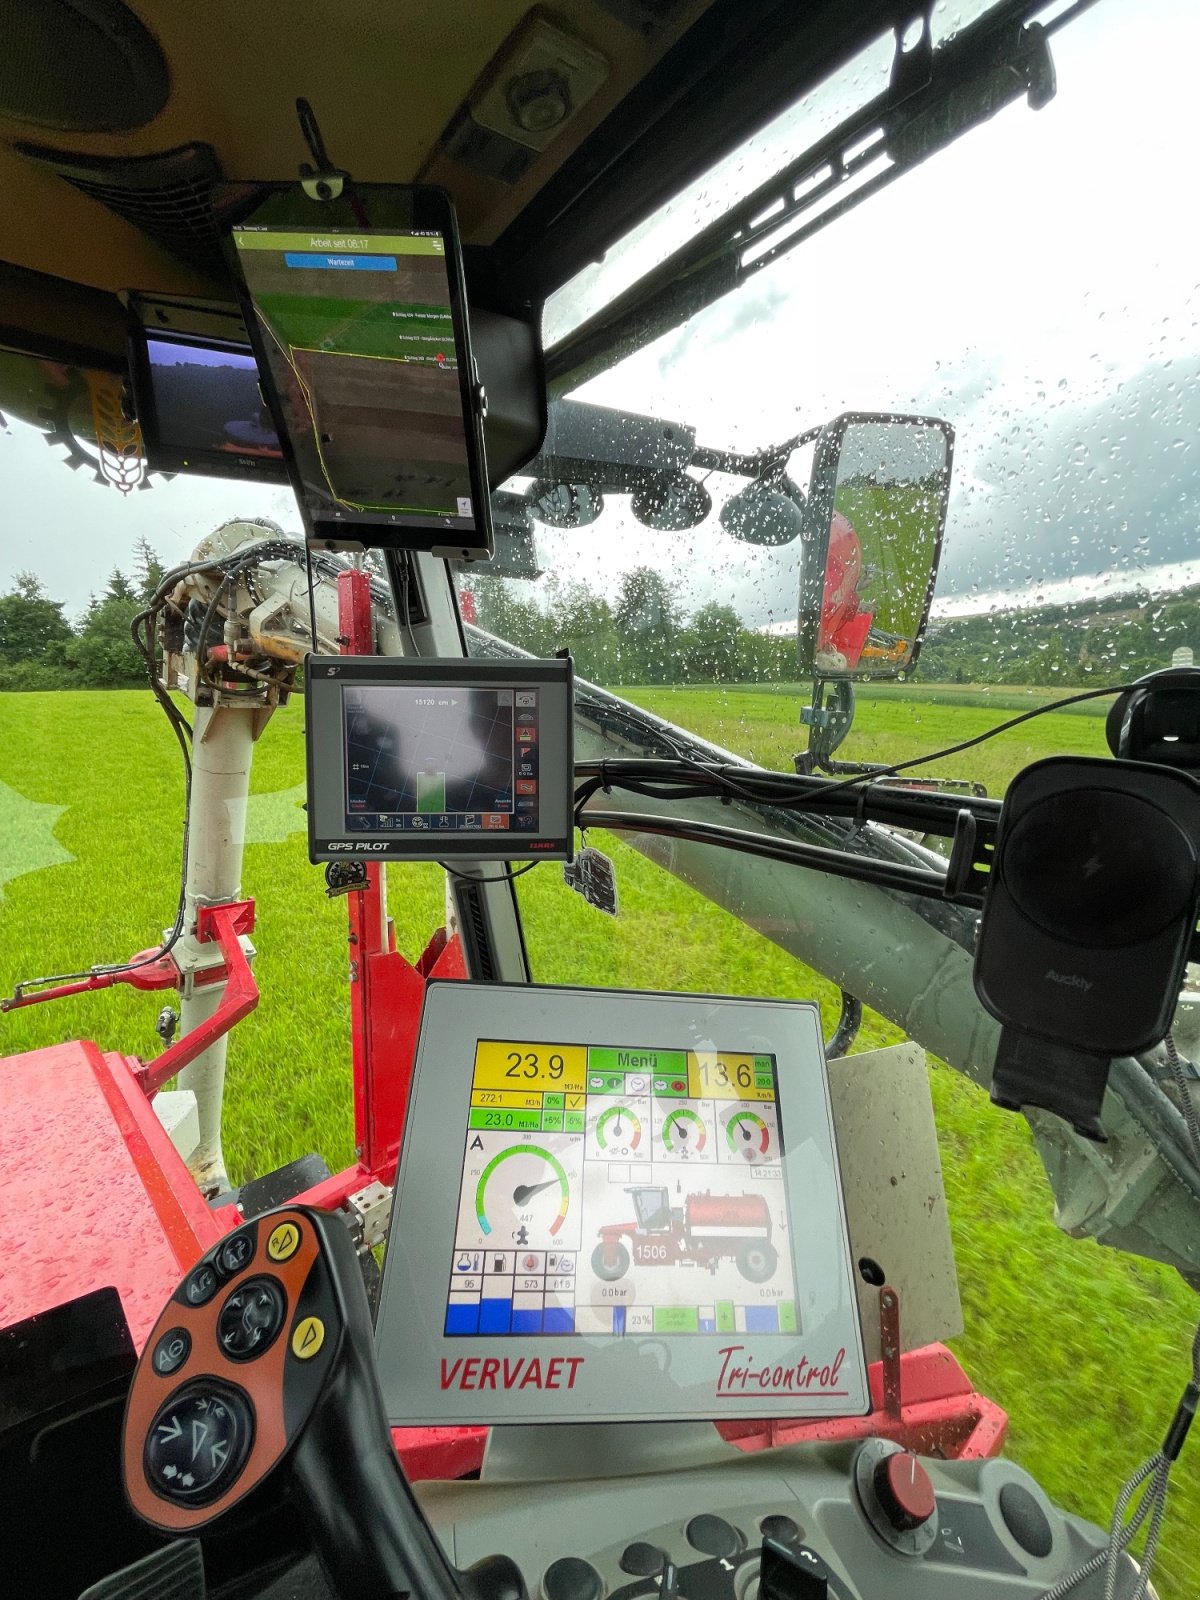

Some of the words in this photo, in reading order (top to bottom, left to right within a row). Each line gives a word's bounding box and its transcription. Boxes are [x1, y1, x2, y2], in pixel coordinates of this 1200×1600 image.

[310, 238, 332, 248] Arbeit
[333, 239, 346, 248] seit
[327, 258, 355, 267] Wartezeit
[327, 842, 354, 851] GPS
[355, 842, 390, 851] PILOT
[505, 1052, 564, 1080] 23.9
[618, 1052, 658, 1068] Menü
[700, 1061, 752, 1088] 13.6
[480, 1093, 503, 1103] 272.1
[546, 1096, 560, 1105] 0%
[485, 1112, 514, 1126] 23.0
[470, 1134, 484, 1151] A
[519, 1214, 534, 1223] 447
[636, 1244, 667, 1260] 1506
[464, 1279, 475, 1289] 95
[524, 1279, 539, 1289] 573
[440, 1356, 585, 1390] VERVAET
[716, 1346, 846, 1391] Tri-control
